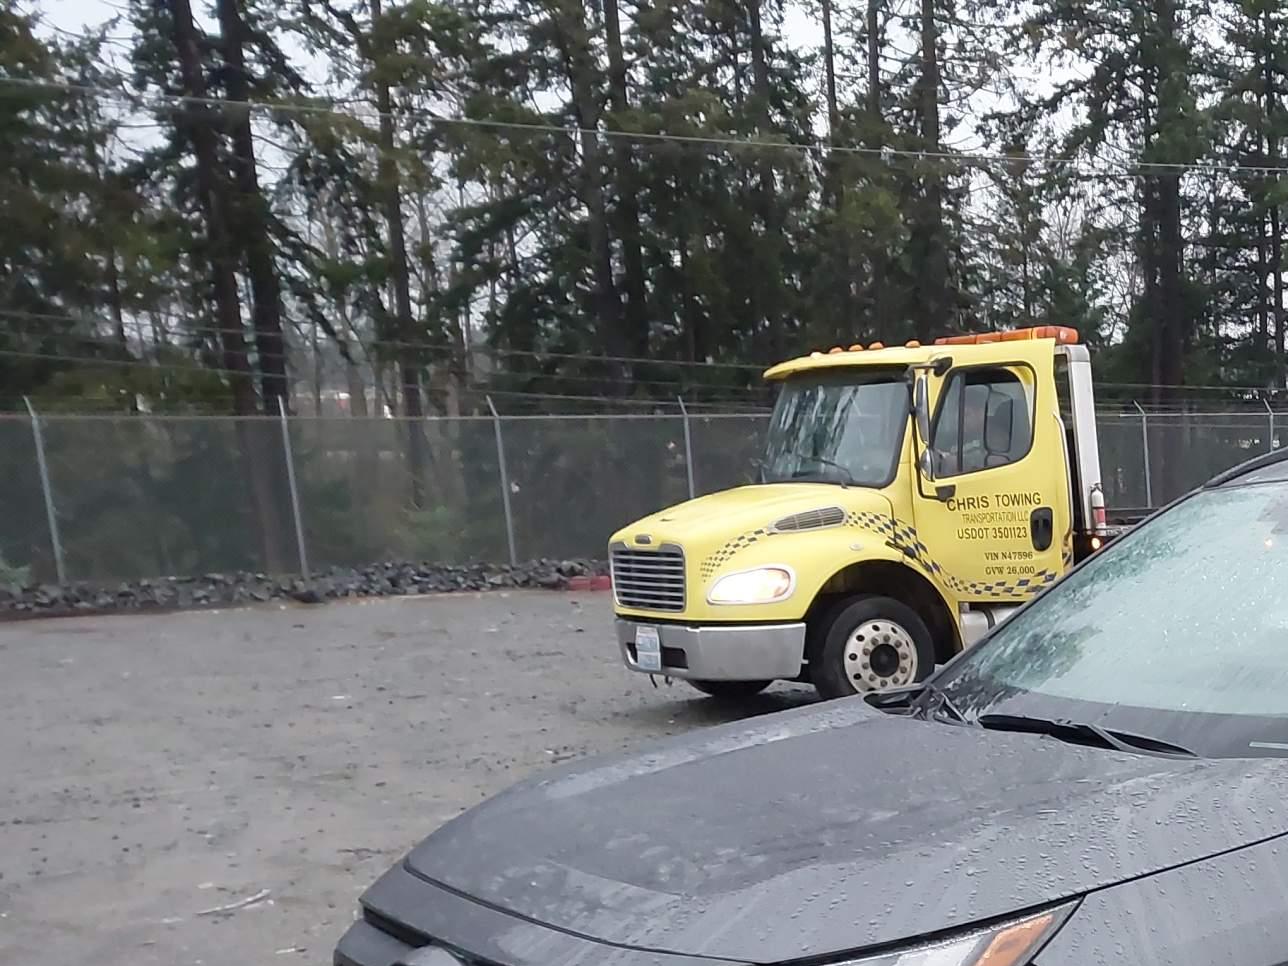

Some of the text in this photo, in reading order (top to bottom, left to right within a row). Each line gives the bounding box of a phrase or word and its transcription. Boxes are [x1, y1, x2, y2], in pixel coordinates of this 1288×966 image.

[946, 492, 1042, 512] CHRIS TOWING
[962, 510, 1029, 524] TRANSPORTATION LLC
[957, 526, 1028, 540] USDOT 3501123
[984, 552, 999, 561] VIN
[985, 566, 1035, 575] GVW 26,000
